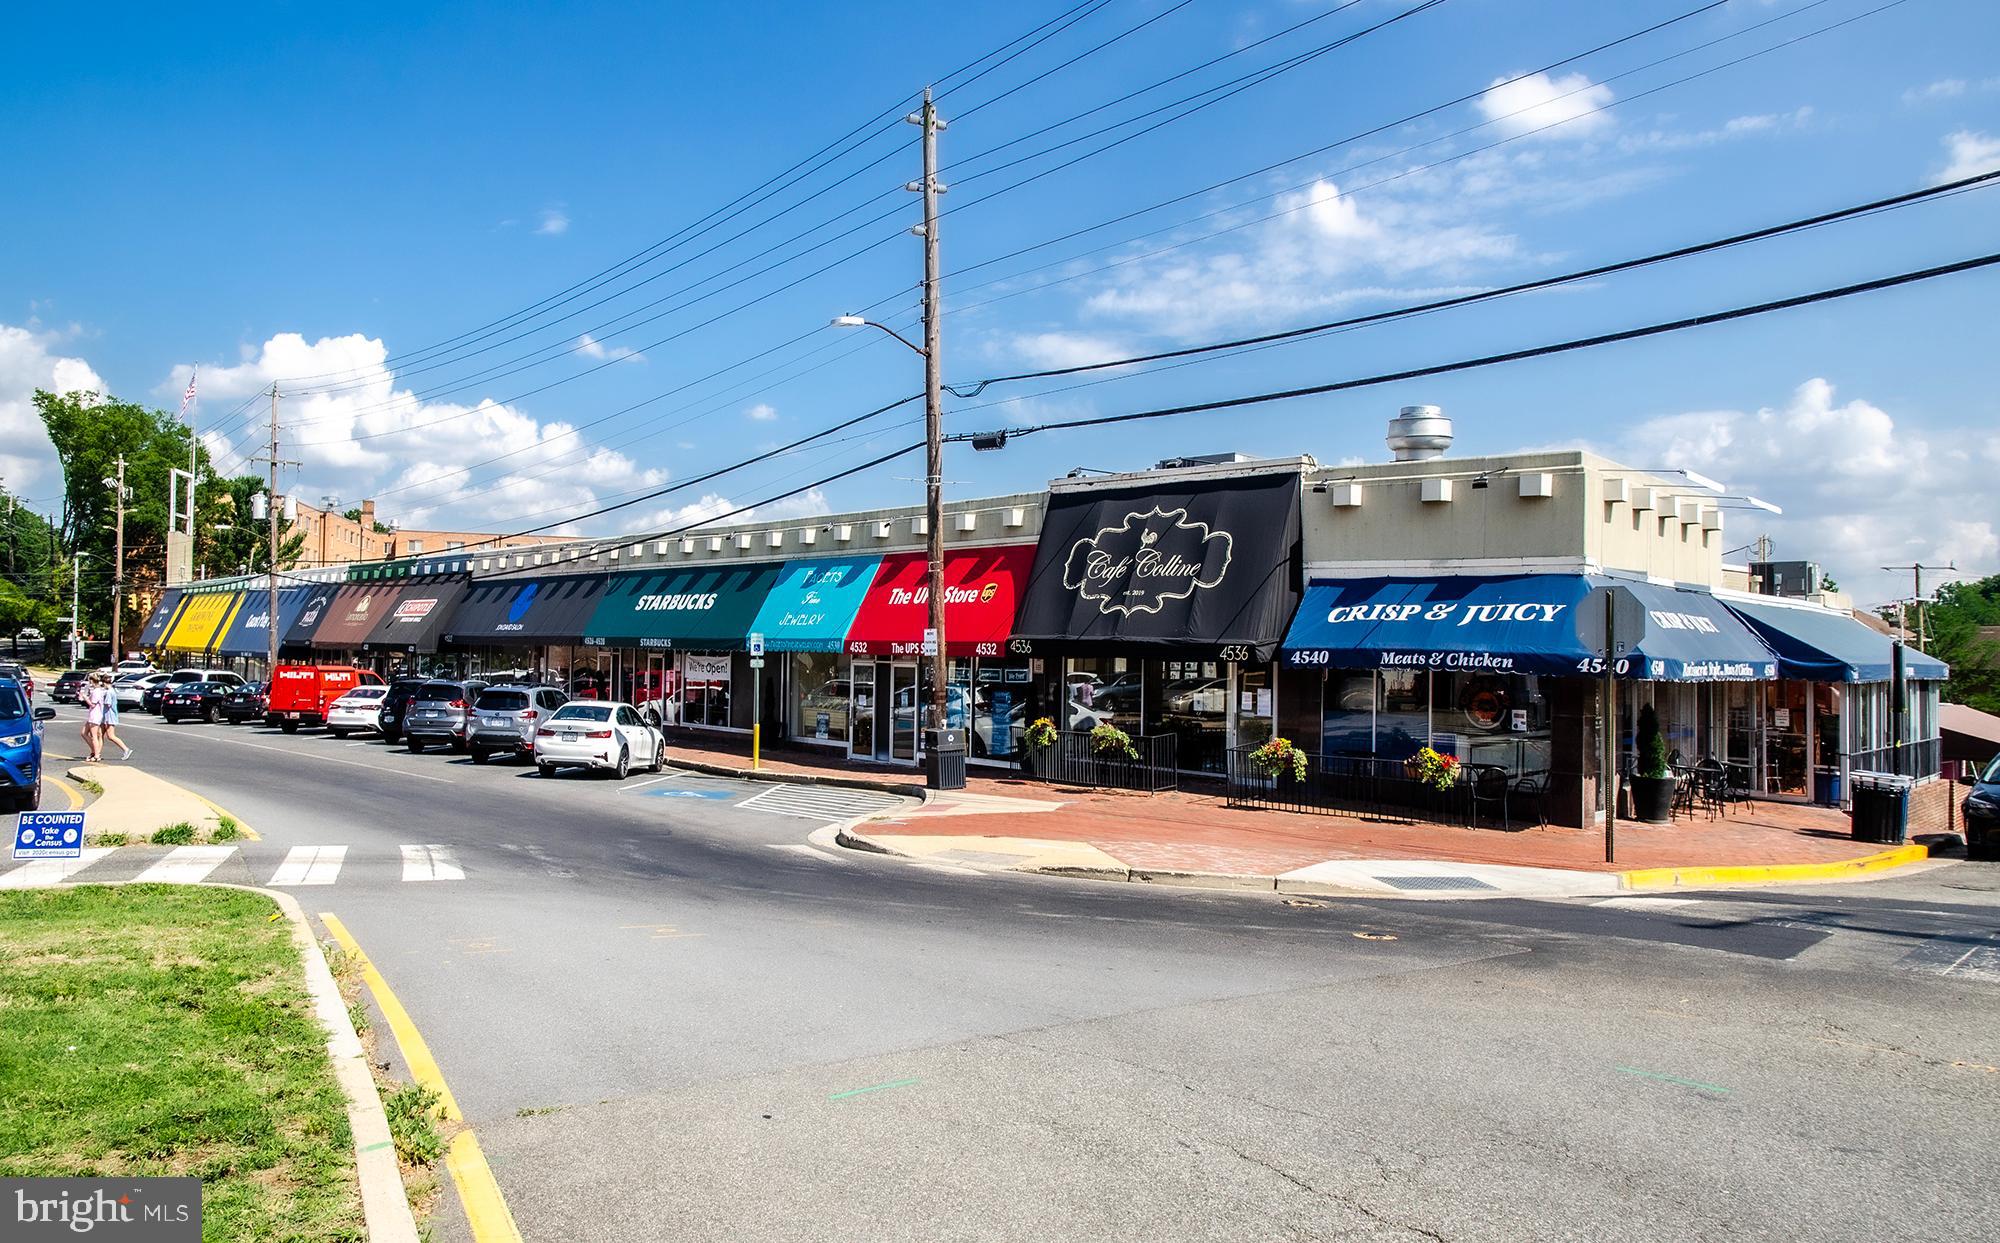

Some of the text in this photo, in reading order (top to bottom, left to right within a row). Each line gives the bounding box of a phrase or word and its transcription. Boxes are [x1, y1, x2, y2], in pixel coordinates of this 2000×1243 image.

[1087, 548, 1202, 587] Café Colline
[635, 593, 718, 611] STARBUCKS
[888, 588, 912, 605] The
[943, 586, 979, 603] Store
[779, 612, 825, 626] JEWELRY
[1327, 603, 1568, 627] CRISP & JUICY
[640, 638, 671, 647] STARBUCKS
[850, 642, 867, 653] 4532
[891, 643, 904, 654] The
[905, 643, 919, 654] UPS
[976, 643, 997, 655] 4532
[1010, 640, 1032, 654] 4536
[1219, 646, 1249, 661] 4536
[1291, 651, 1514, 669] 4540 Meats & Chicken
[280, 671, 314, 679] HILTI
[688, 662, 728, 675] We're Open!
[325, 672, 350, 681] HILTI
[22, 814, 83, 825] BE COUNTED
